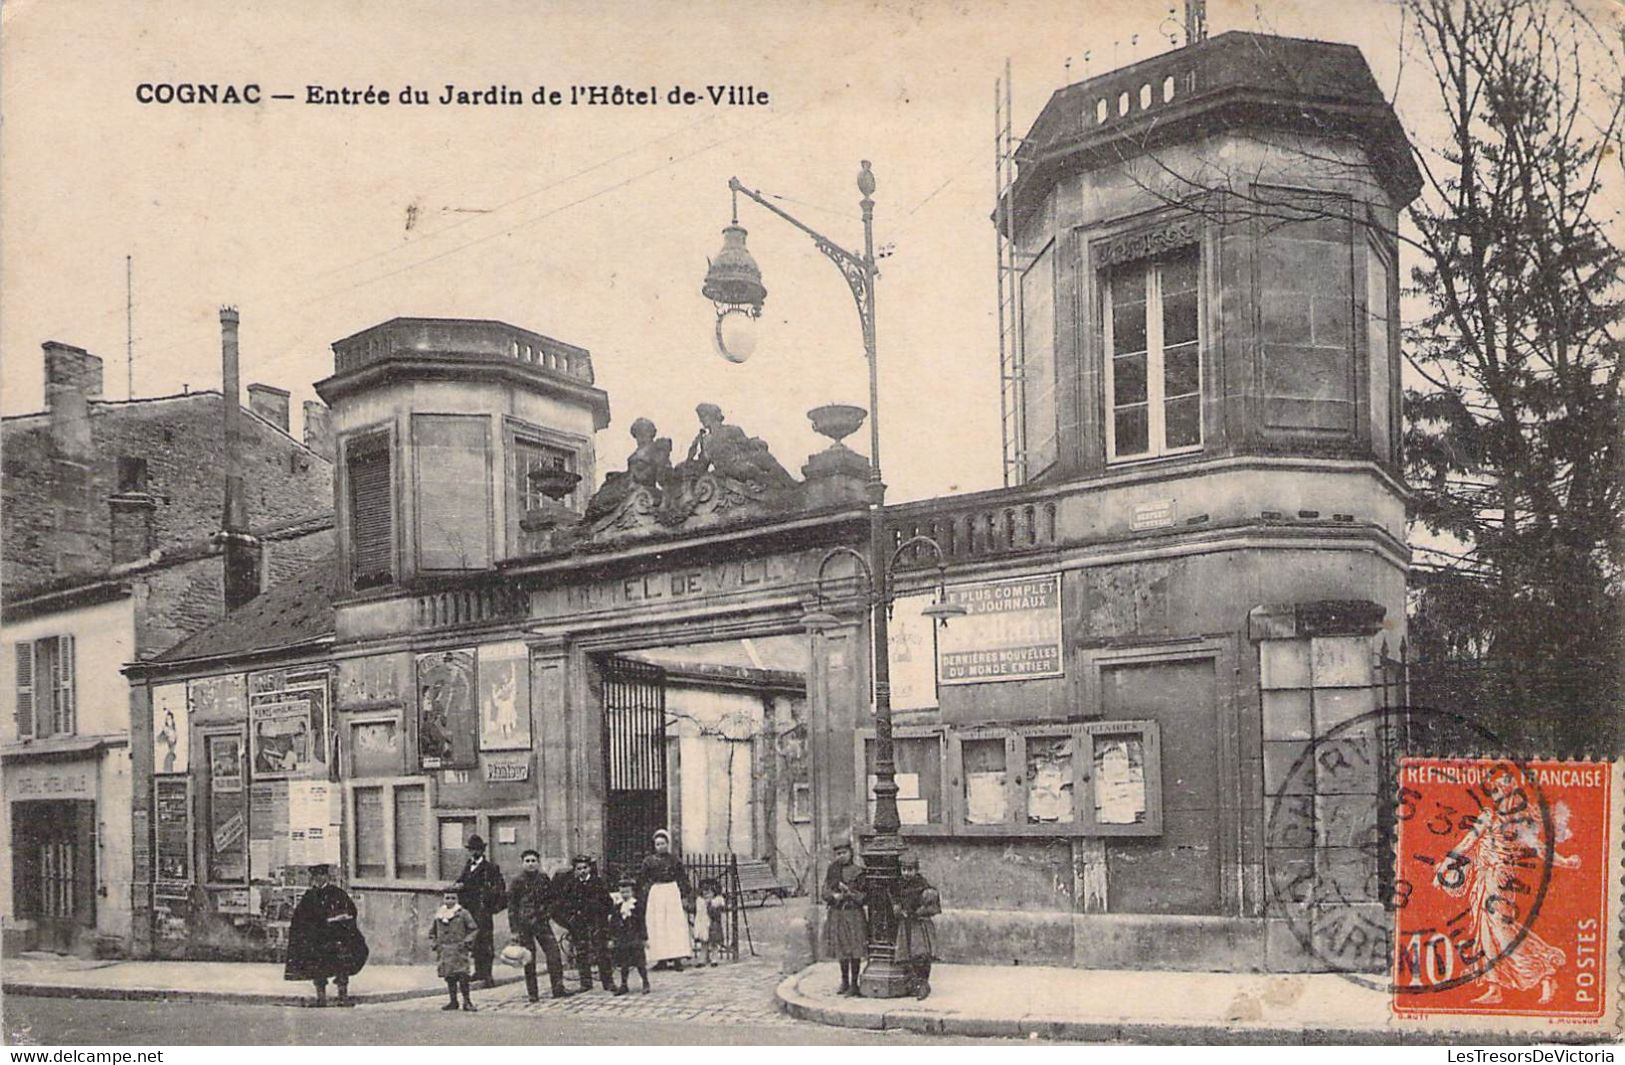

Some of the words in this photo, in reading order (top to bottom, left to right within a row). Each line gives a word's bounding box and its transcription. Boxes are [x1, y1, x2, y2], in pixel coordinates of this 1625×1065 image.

[671, 573, 702, 596] DE
[960, 588, 992, 604] PLUS
[995, 582, 1055, 599] COMPLET
[978, 596, 1047, 613] JOURNAUX
[943, 651, 998, 667] DERNIÈRES
[1000, 647, 1058, 663] NOUVELLES
[949, 668, 965, 678] DU
[969, 663, 1007, 676] MONDE
[1012, 660, 1051, 674] ENTIER
[1408, 933, 1454, 987] 10
[1576, 918, 1598, 1002] POSTES
